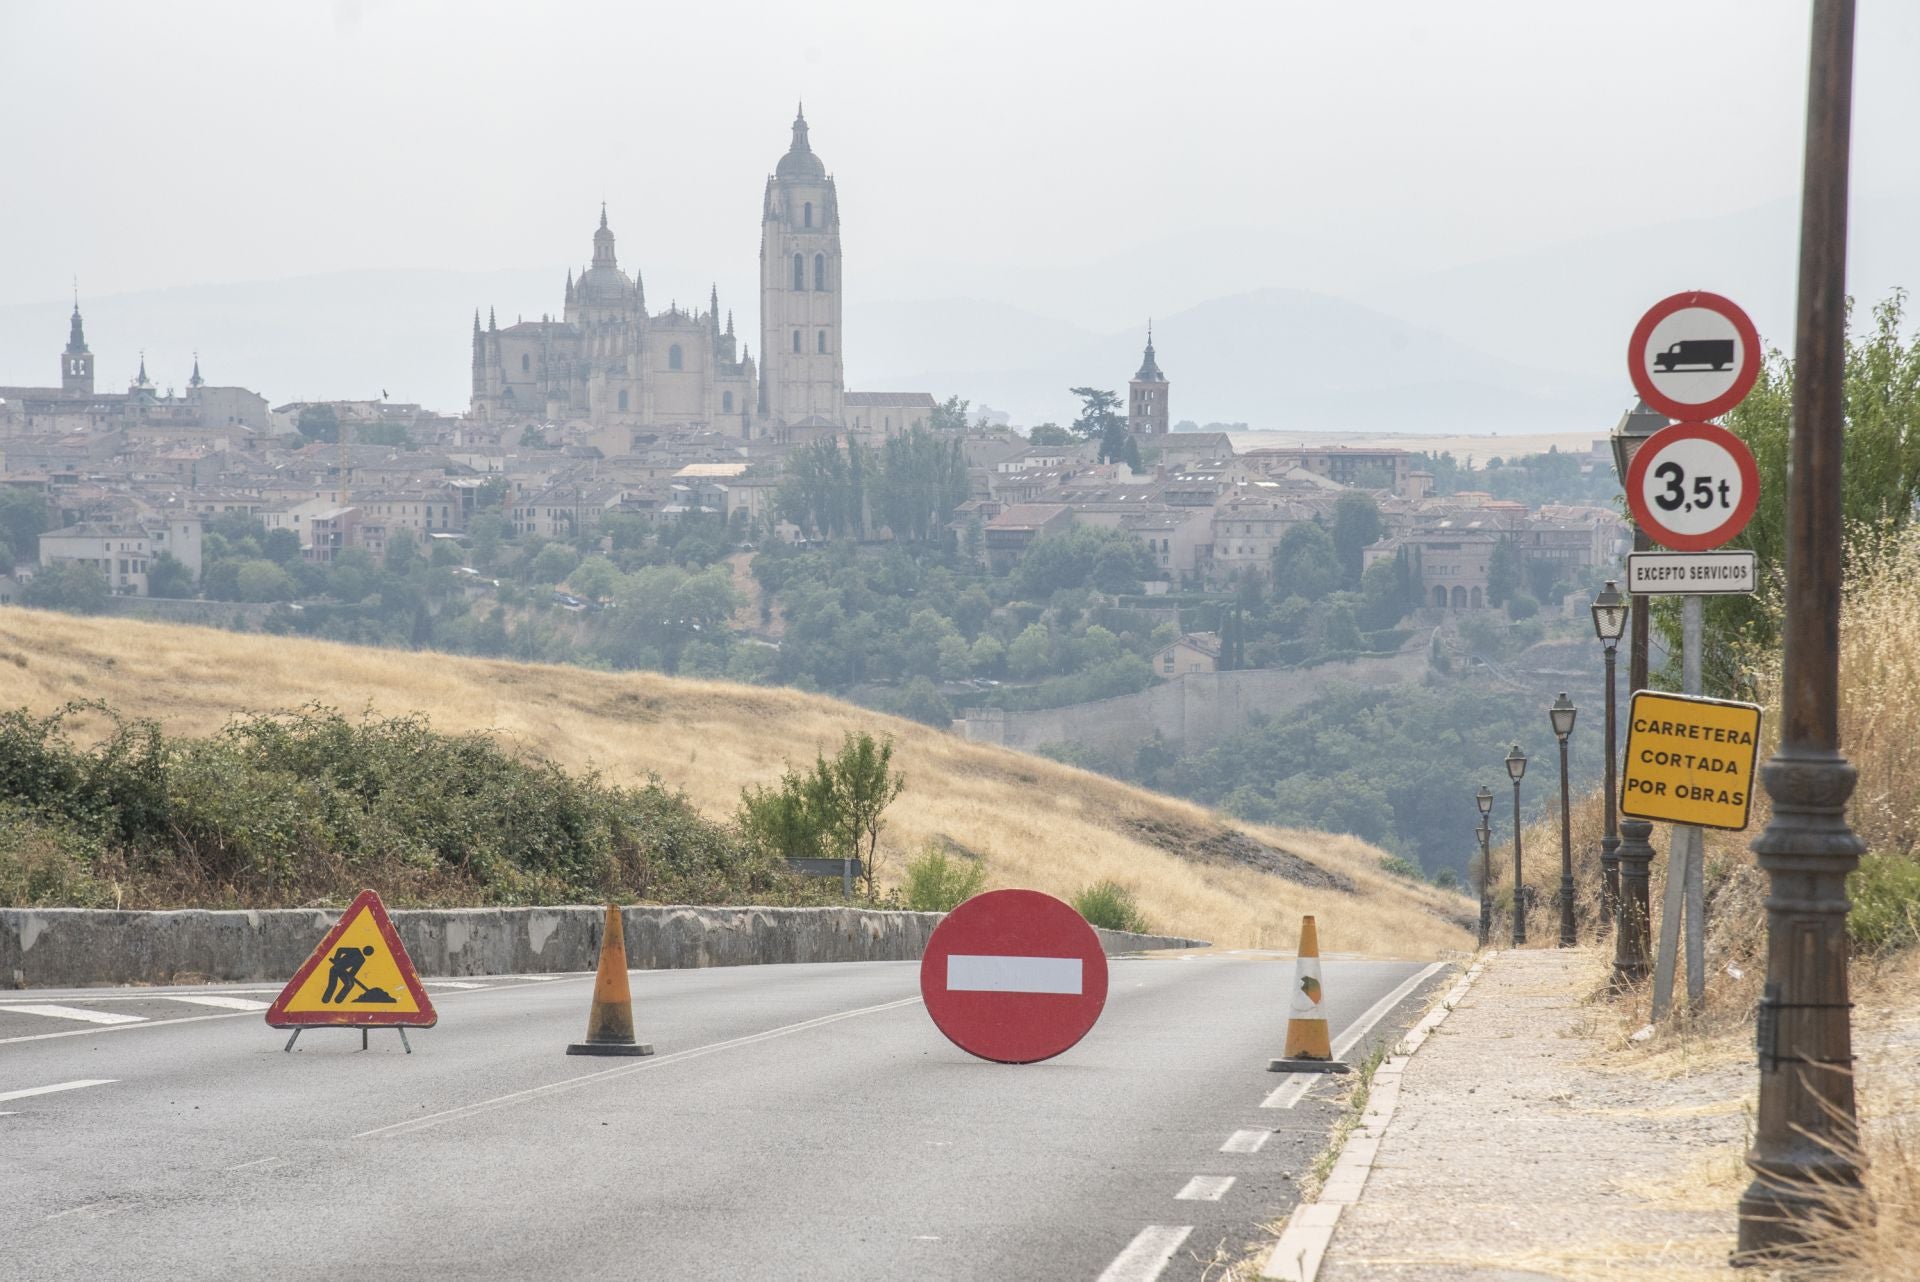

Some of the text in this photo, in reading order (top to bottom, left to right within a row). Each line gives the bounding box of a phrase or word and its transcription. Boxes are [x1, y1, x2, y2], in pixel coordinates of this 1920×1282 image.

[1637, 565, 1747, 581] EXCEPTO SERVICIOS
[1634, 719, 1752, 745] CARRETERA
[1641, 750, 1738, 775] CORTADA
[1628, 778, 1744, 806] POR OBRAS
